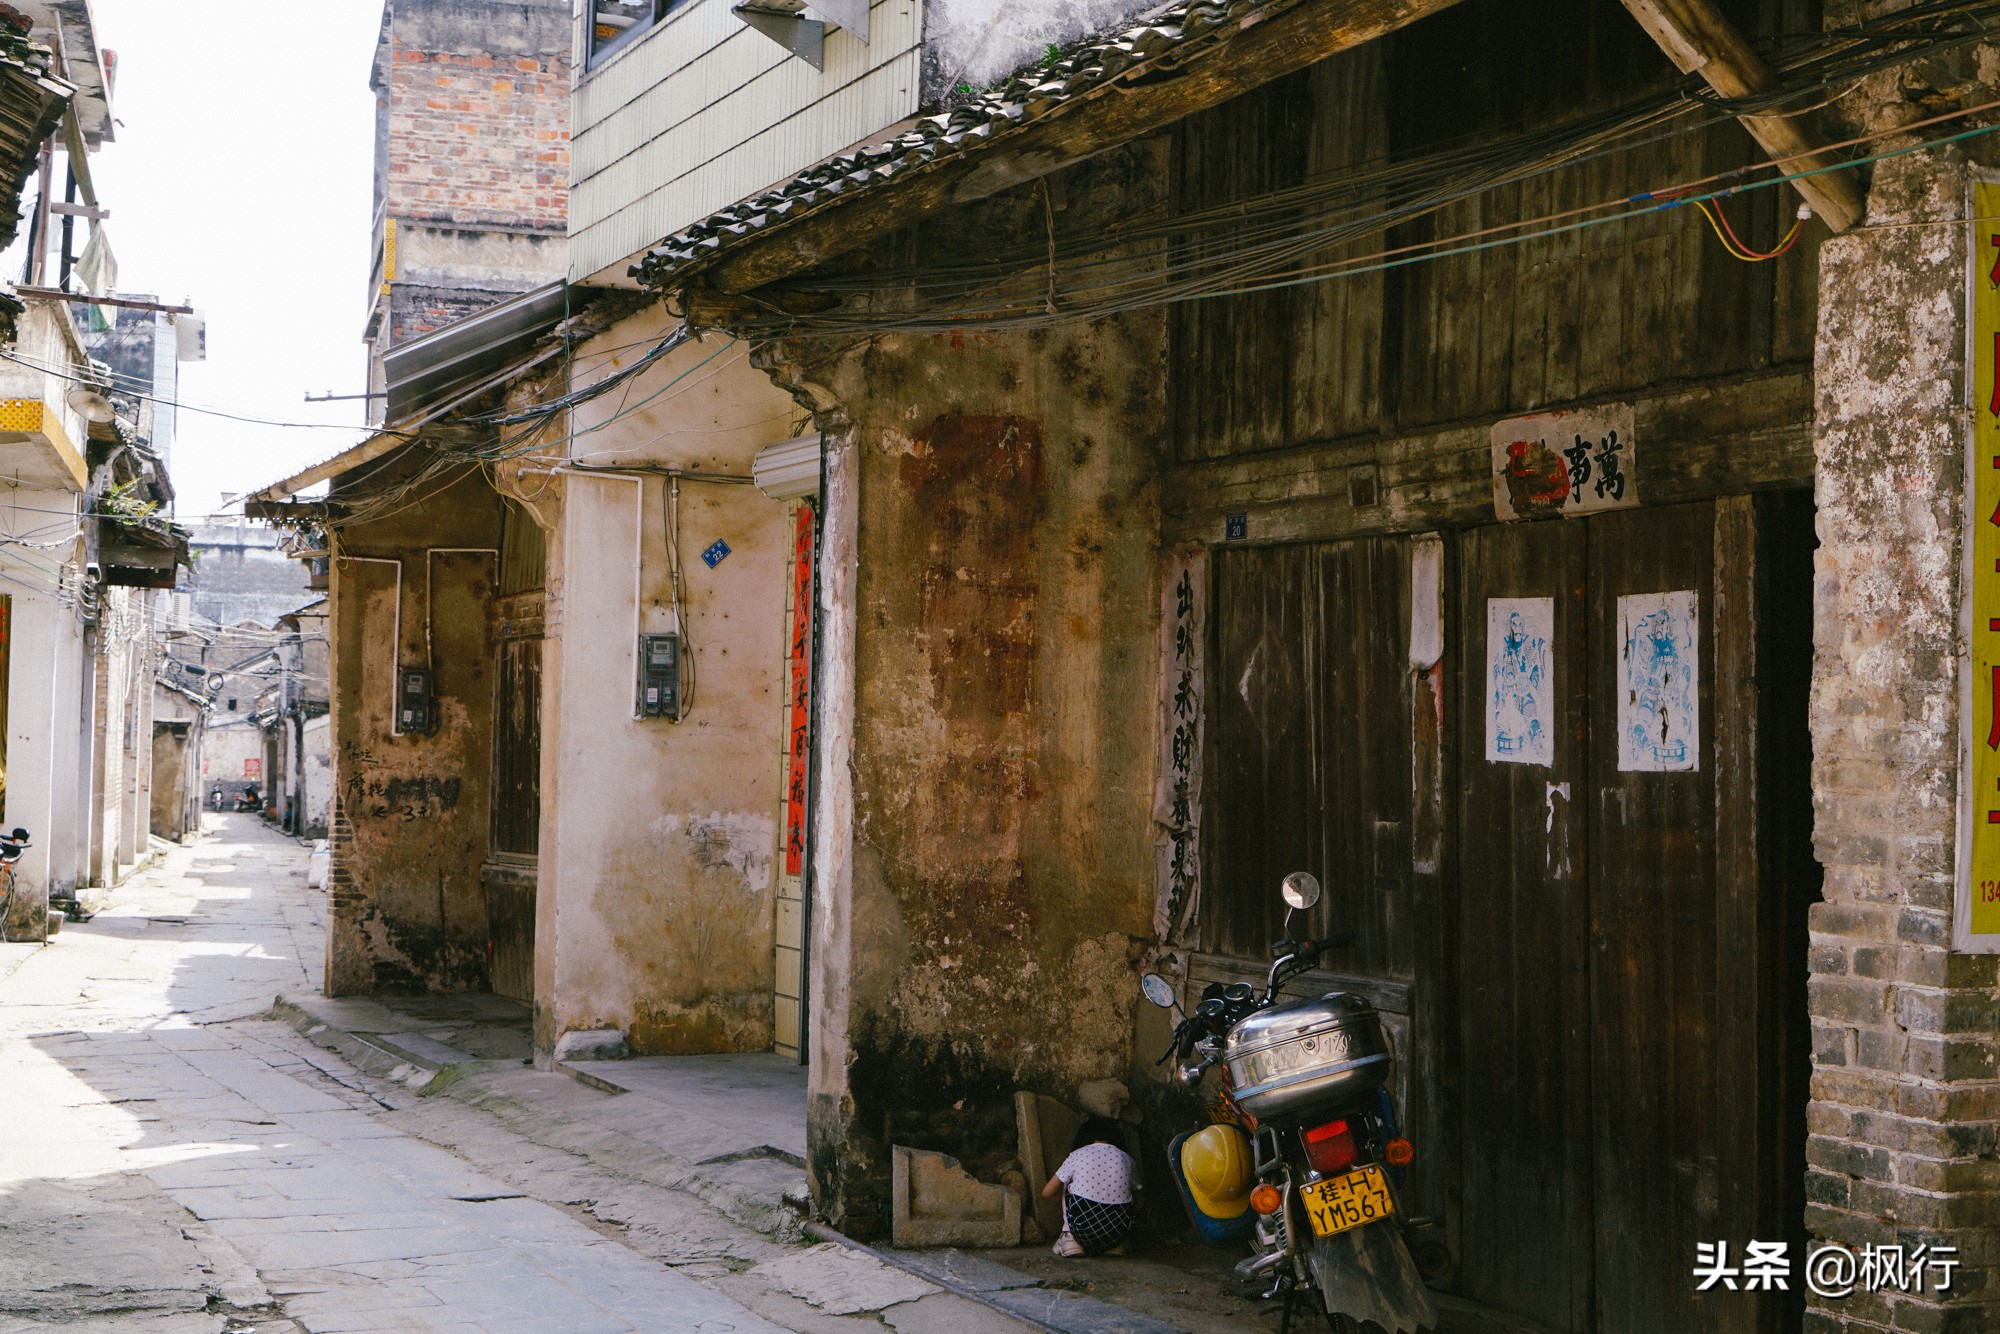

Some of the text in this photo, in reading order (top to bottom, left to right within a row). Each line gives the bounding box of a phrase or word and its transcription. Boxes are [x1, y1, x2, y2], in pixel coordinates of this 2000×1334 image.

[1232, 525, 1241, 537] 20
[712, 550, 724, 562] 22
[1313, 1190, 1387, 1232] YM567
